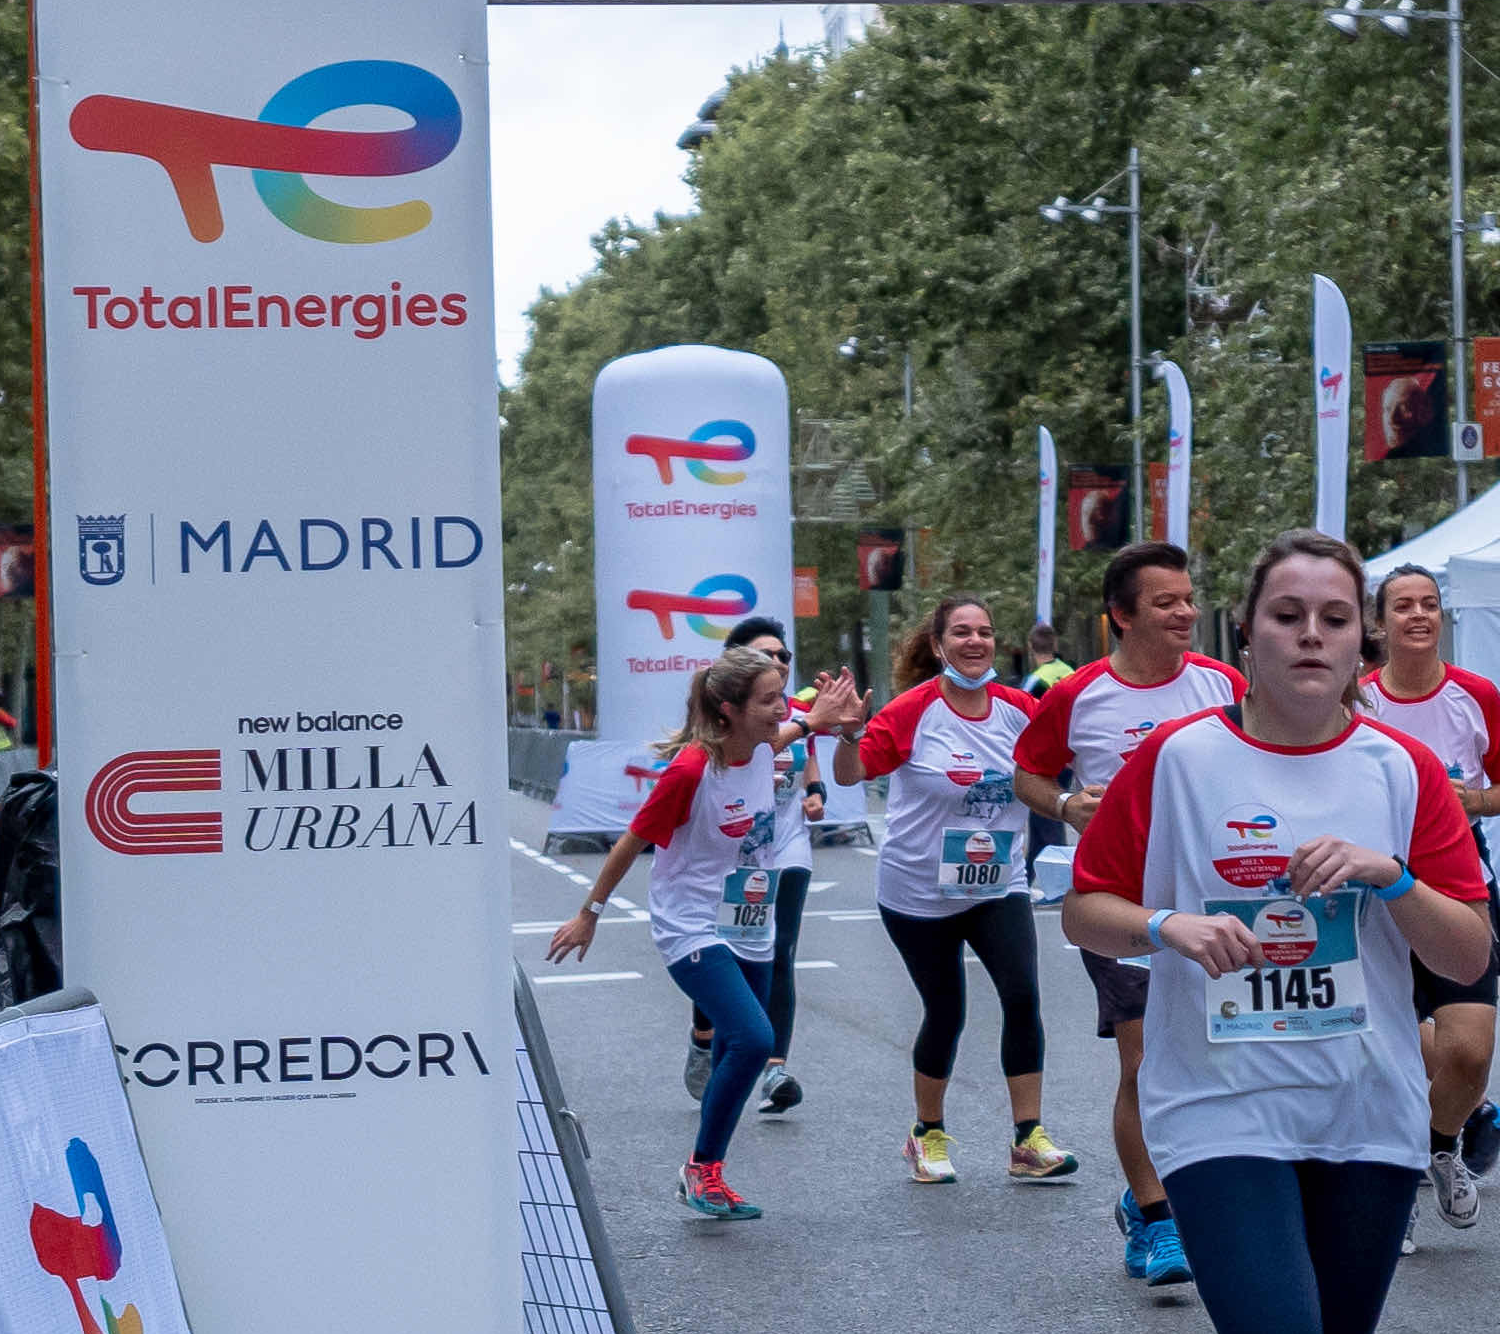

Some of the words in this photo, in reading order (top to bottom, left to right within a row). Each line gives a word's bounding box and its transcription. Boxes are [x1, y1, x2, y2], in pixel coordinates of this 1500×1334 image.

[72, 281, 469, 340] TotalEnergies
[624, 500, 757, 521] TotalEnergies
[180, 515, 485, 574] MADRID
[238, 713, 291, 735] new
[296, 709, 404, 733] balance
[242, 742, 453, 794] MILLA
[244, 799, 485, 853] URBANA
[955, 863, 1000, 885] 1080
[733, 904, 769, 927] 1025
[1244, 966, 1336, 1012] 1145
